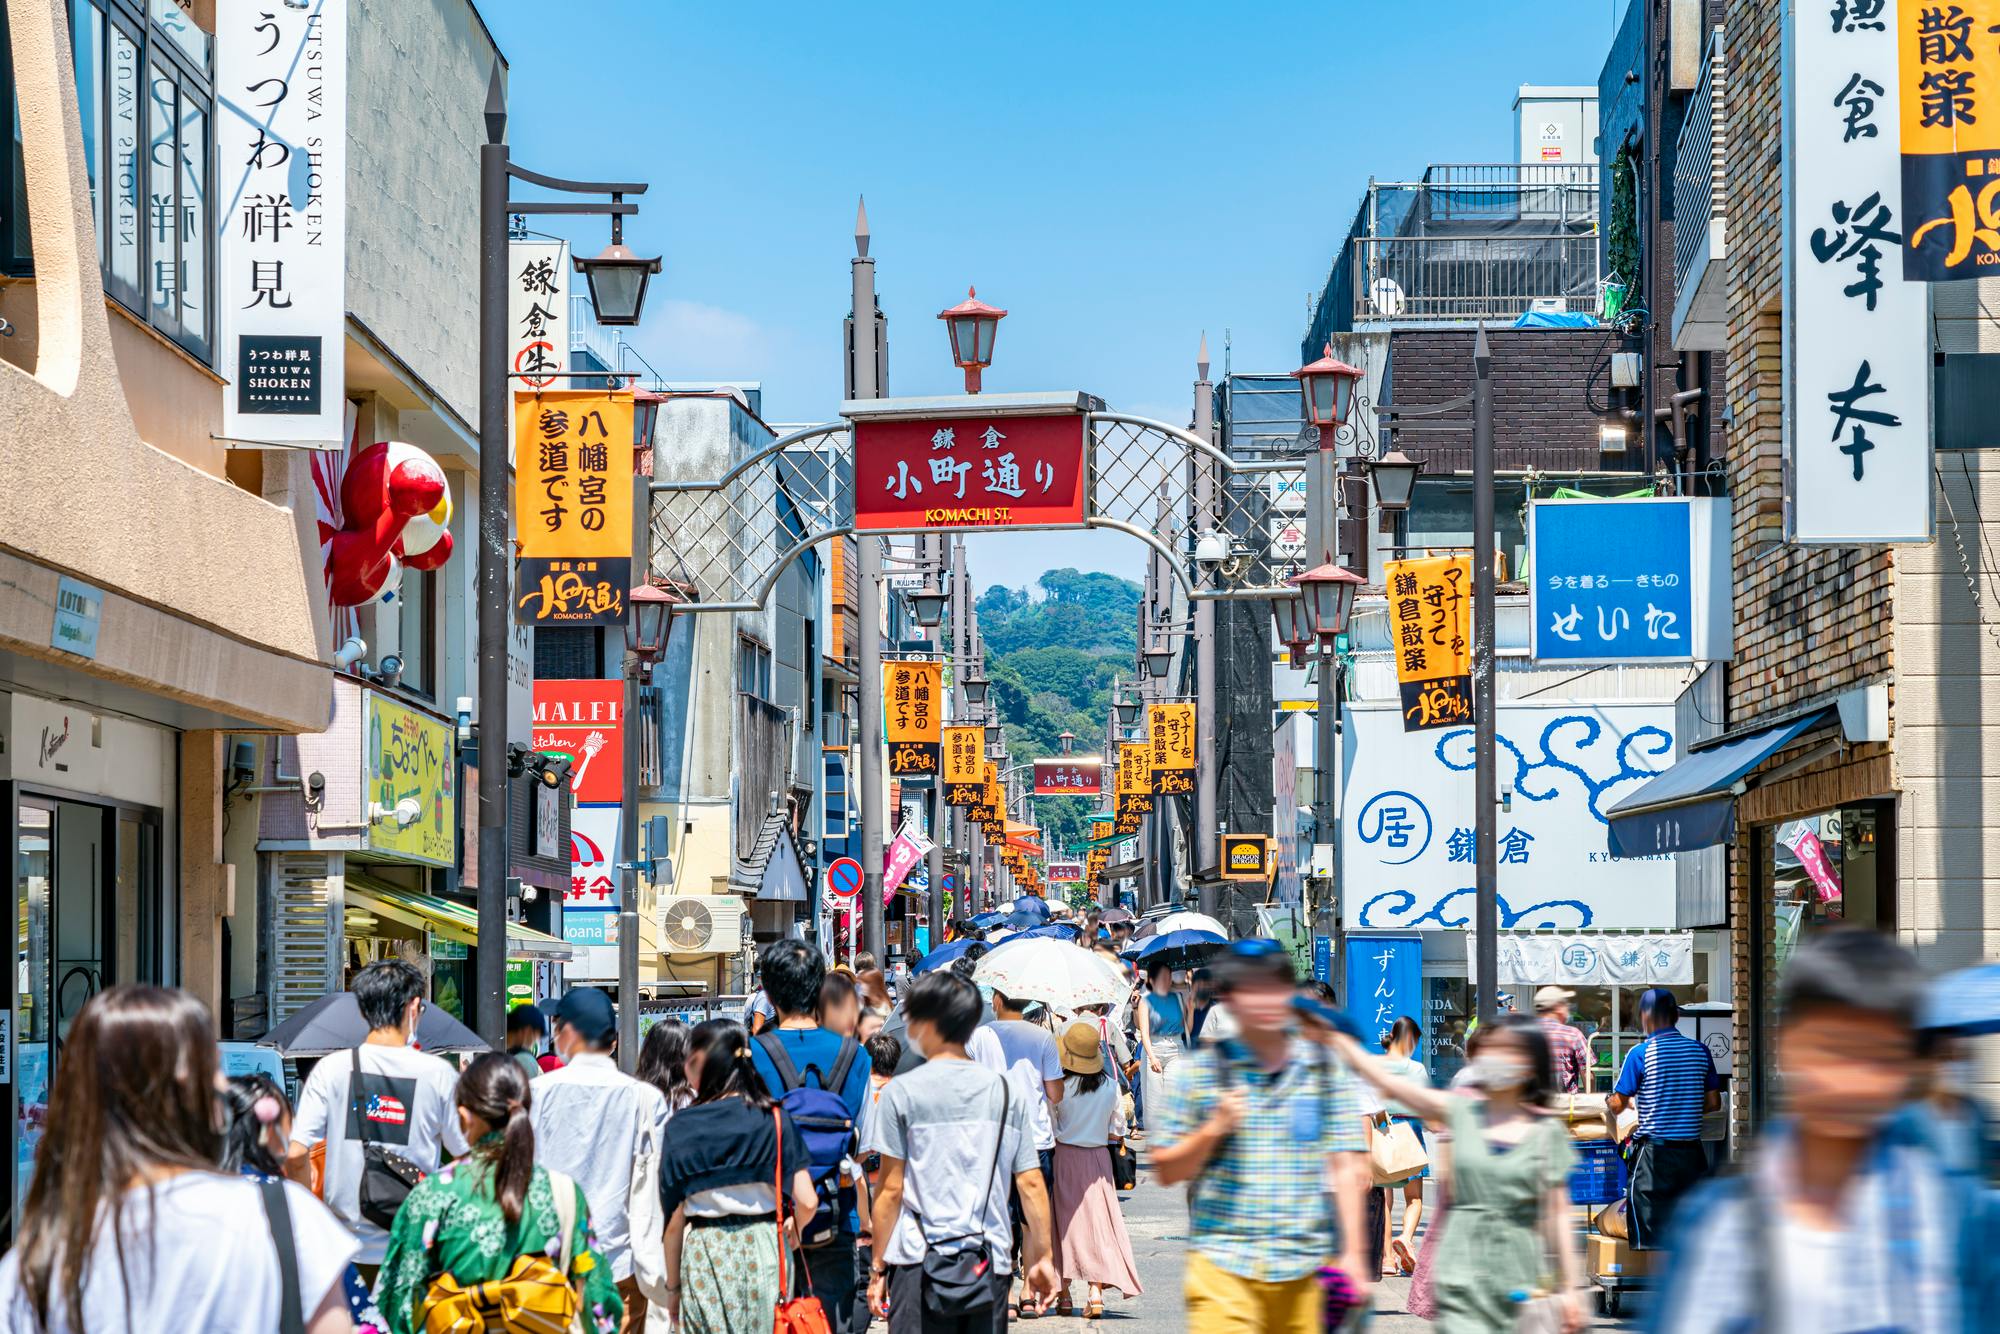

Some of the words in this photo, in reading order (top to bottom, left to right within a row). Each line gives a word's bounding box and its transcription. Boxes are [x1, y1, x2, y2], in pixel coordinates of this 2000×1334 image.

[306, 14, 323, 121] UTSUWA
[241, 11, 294, 310] うつわ祥見
[306, 137, 323, 247] SHOKEN
[249, 349, 311, 362] うつわ祥見
[249, 366, 311, 375] UTSUWA
[249, 378, 311, 389] SHOKEN
[931, 426, 1007, 450] 鎌倉
[539, 409, 570, 533] 参道です
[578, 410, 609, 532] 八幡宮の
[885, 451, 1055, 500] 小町通り
[925, 508, 991, 522] KOMACHI
[994, 507, 1013, 521] ST.
[519, 572, 624, 620] 小町通り
[1422, 585, 1446, 646] 守って
[1443, 567, 1465, 656] マナーを
[1394, 571, 1427, 672] 鎌倉散策
[1550, 602, 1681, 642] せいた
[895, 670, 910, 730] 参道です
[914, 671, 930, 729] 八幡宮の
[533, 733, 576, 752] itchen
[1043, 774, 1092, 787] 小町通り
[1446, 826, 1535, 864] 鎌倉
[1620, 950, 1671, 968] 鎌倉
